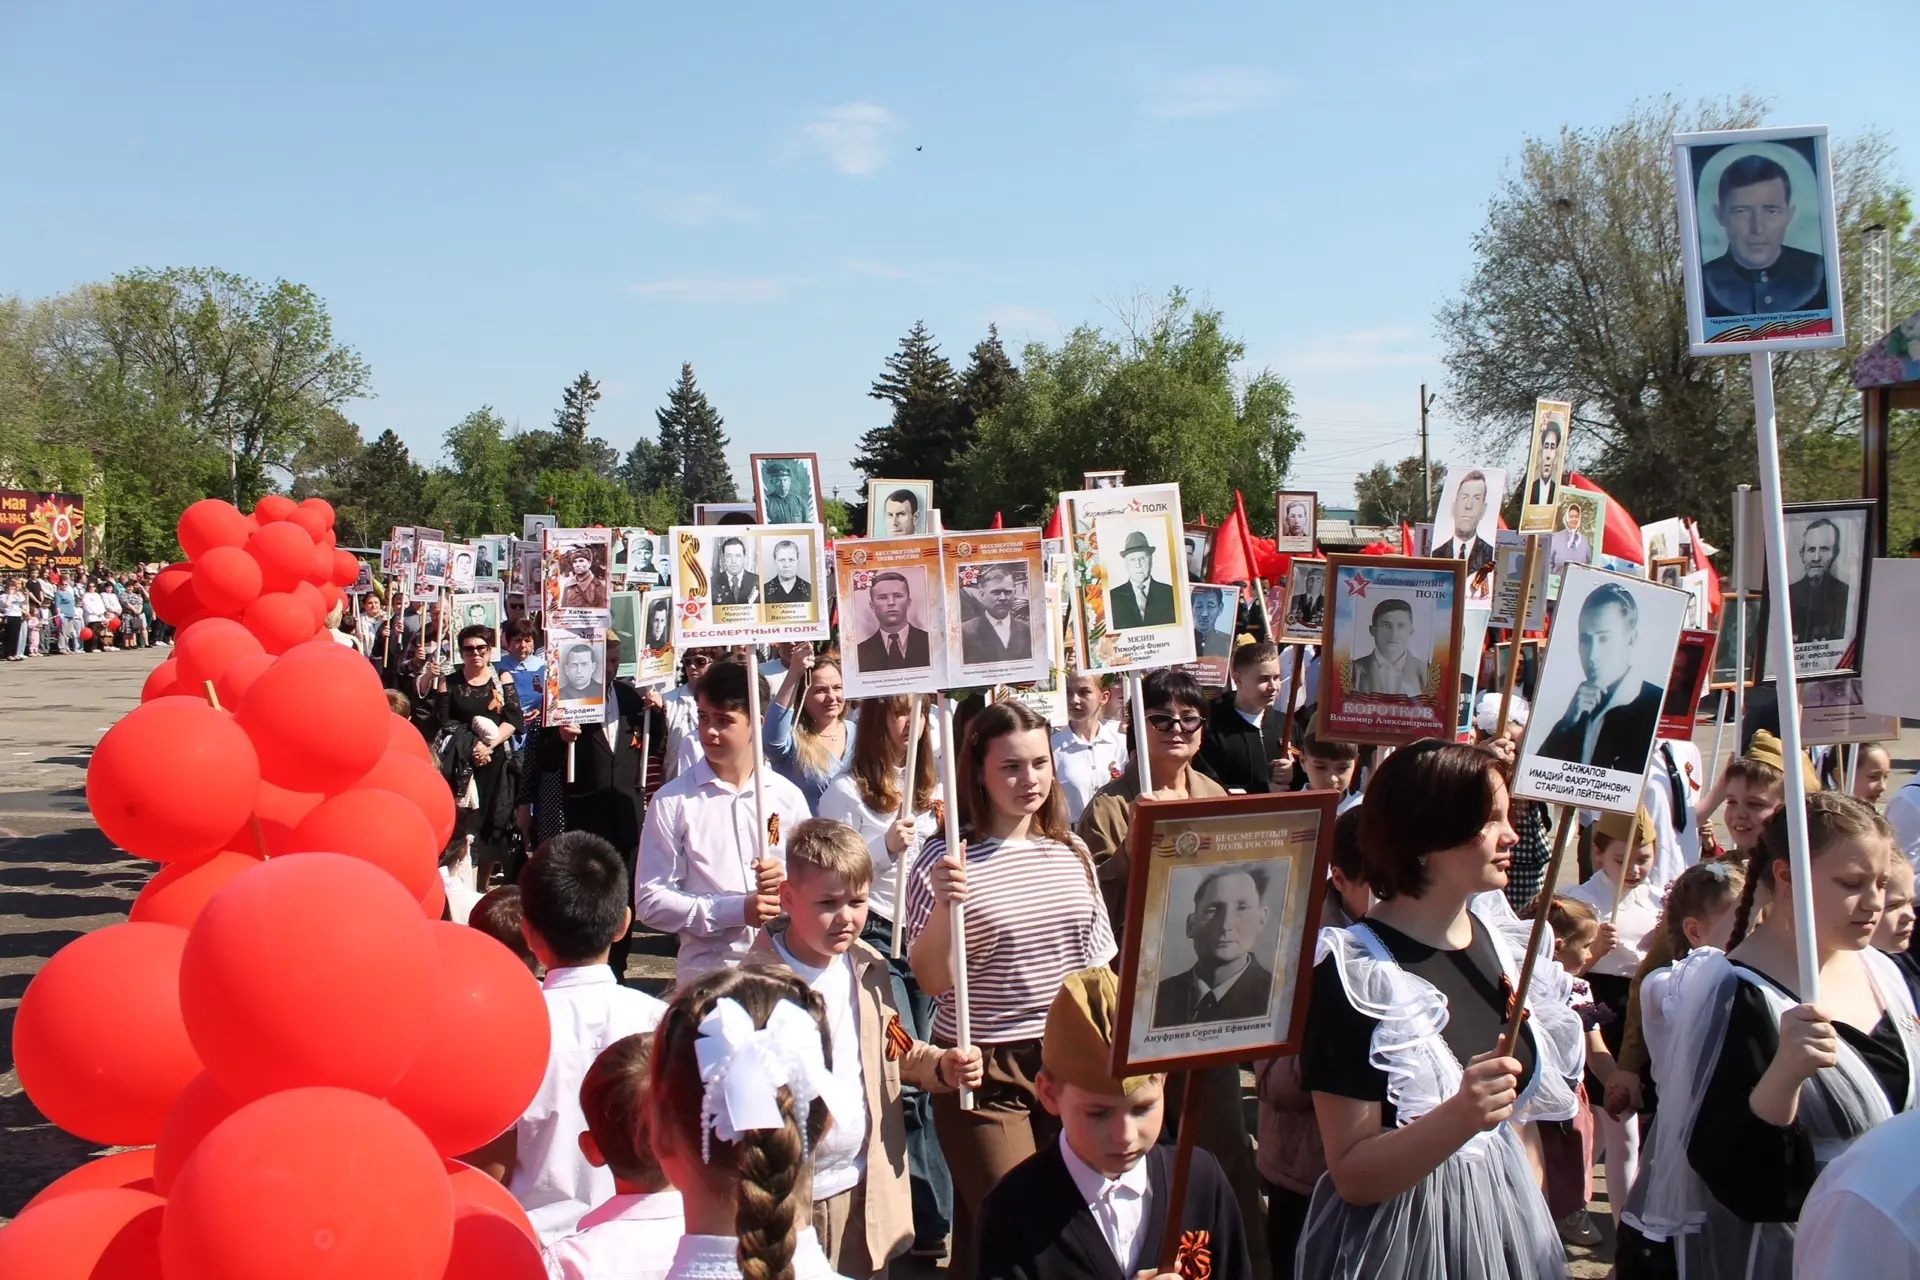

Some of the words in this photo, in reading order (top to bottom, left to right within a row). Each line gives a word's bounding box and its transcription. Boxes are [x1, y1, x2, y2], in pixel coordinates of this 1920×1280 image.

[2, 497, 27, 511] мая
[1142, 503, 1168, 512] ПОЛК
[980, 541, 1024, 550] БЕССМЕРТНЫЙ
[875, 547, 921, 557] БЕССМЕРТНЫЙ
[1415, 589, 1447, 599] ПОЛК
[683, 627, 780, 638] БЕССМЕРТНЫЙ
[784, 625, 819, 633] ПОЛК
[1127, 634, 1155, 643] МЯЗИН
[1113, 643, 1145, 653] Тимофей
[1146, 641, 1170, 649] Фомич
[1795, 643, 1829, 652] САВЕНКОВ
[1807, 650, 1844, 659] ФРОЛОВИЧ
[1342, 701, 1433, 719] КОРОТКОВ
[1329, 713, 1373, 725] Владимир
[1375, 716, 1443, 729] Александрович
[1528, 768, 1563, 782] ИМАДИЙ
[1564, 775, 1632, 793] ФАХРУТДИНОВИЧ
[1534, 781, 1575, 796] СТАРШИЙ
[1574, 788, 1621, 803] ЛЕЙТЕНАНТ
[1215, 828, 1288, 842] БЕССМЕРТНЫЙ
[1216, 842, 1243, 851] ПОЛК
[1244, 839, 1284, 849] РОССИИ
[1143, 1032, 1190, 1043] Ануфриев
[1192, 1028, 1223, 1038] Сергей
[1225, 1021, 1272, 1033] Ефимович
